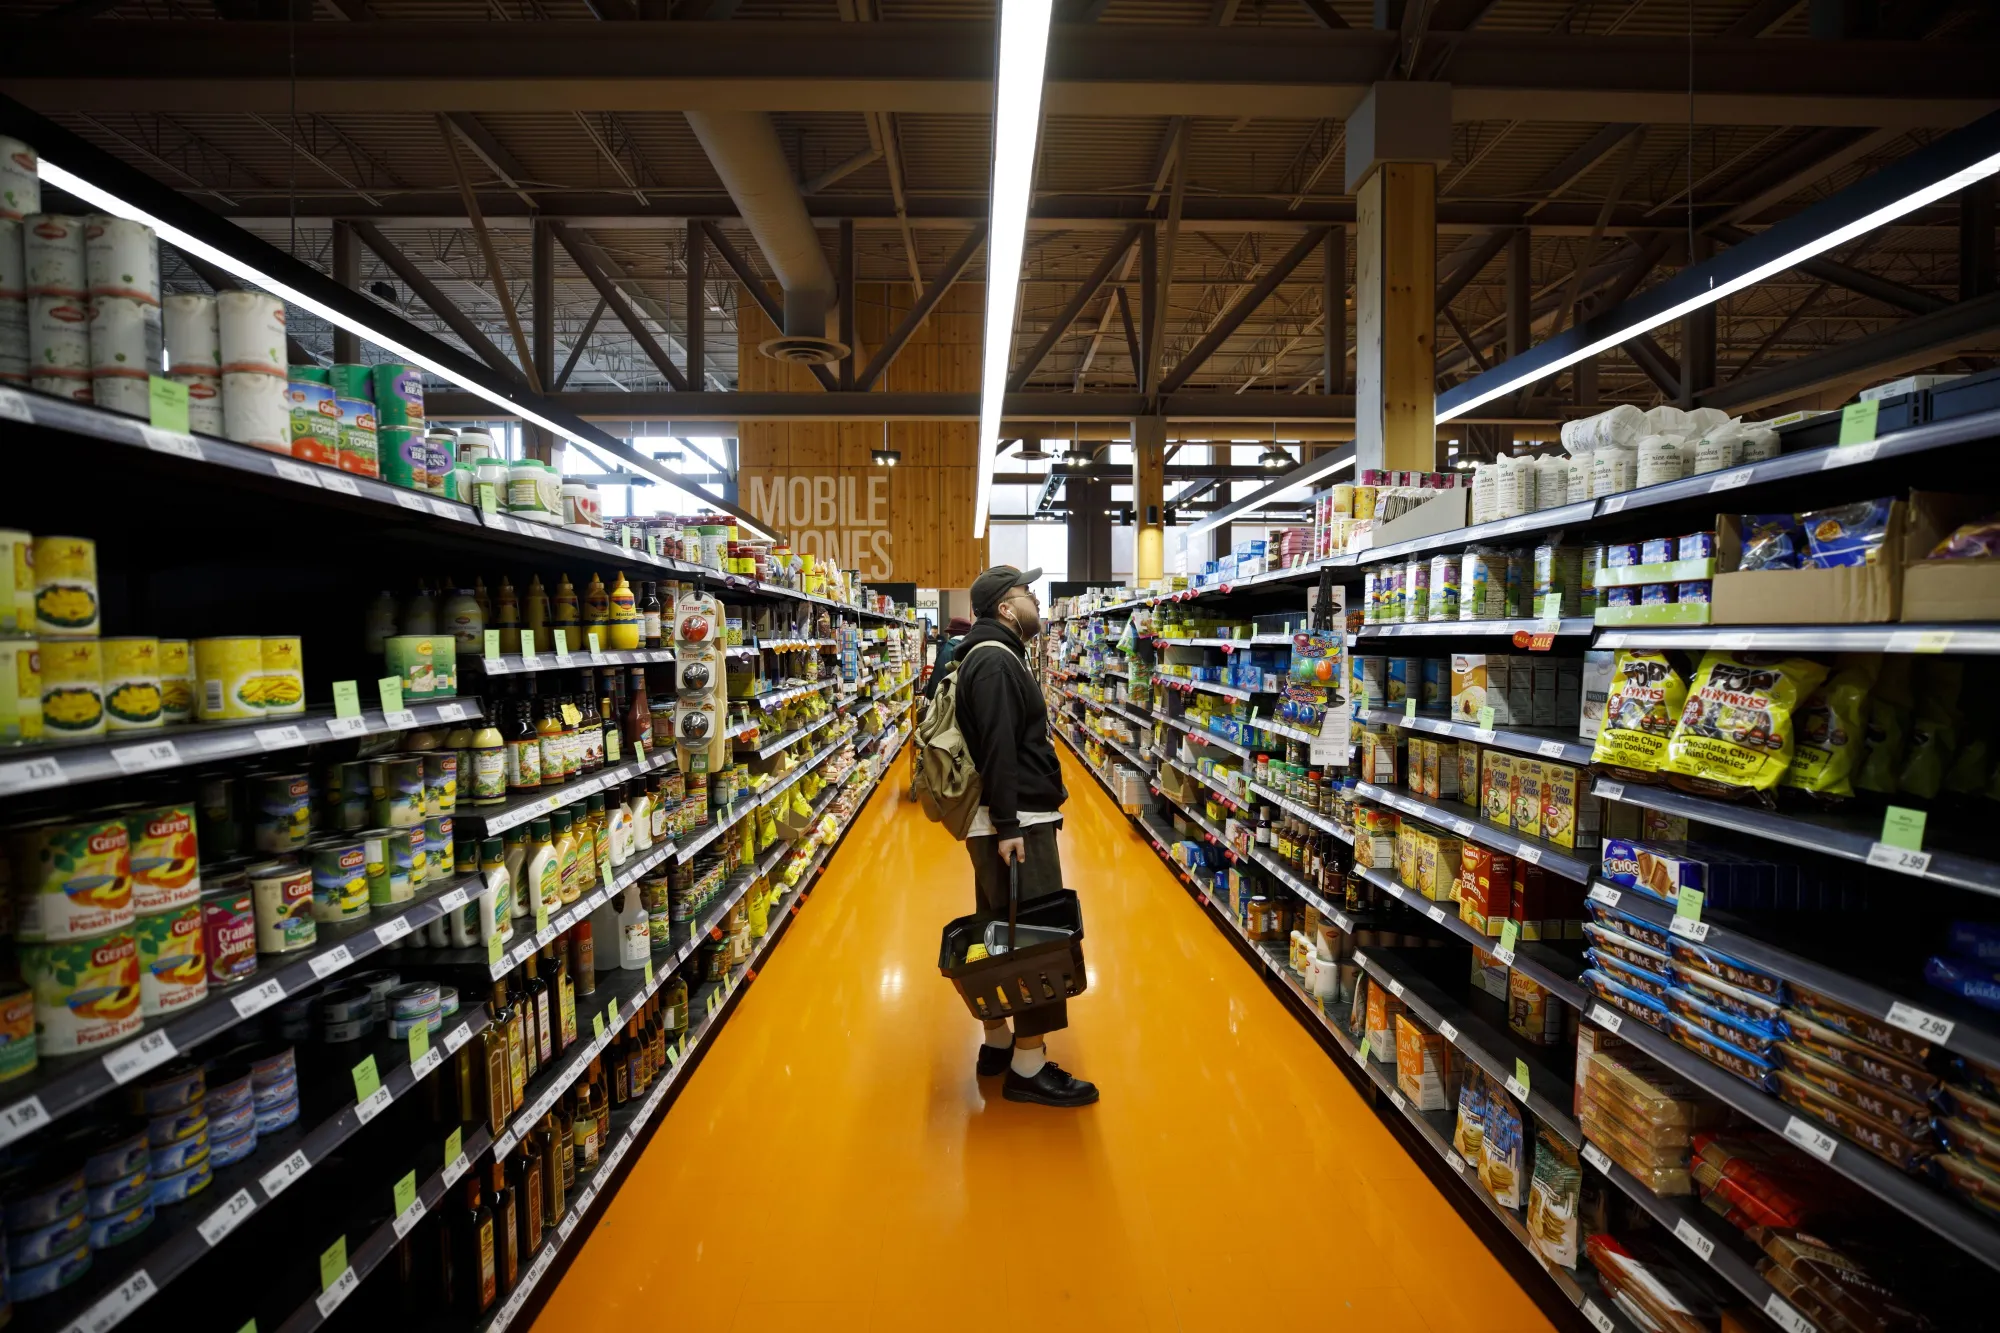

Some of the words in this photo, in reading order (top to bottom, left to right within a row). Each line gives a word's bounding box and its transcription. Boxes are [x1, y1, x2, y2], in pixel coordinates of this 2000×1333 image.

[405, 387, 422, 397] BEA
[311, 423, 338, 437] TOMA
[750, 476, 887, 527] MOBILE
[682, 604, 701, 612] Timer
[1514, 635, 1529, 645] SALE
[1532, 637, 1552, 648] SALE
[727, 664, 739, 674] its
[1587, 692, 1606, 702] WHOLE
[1609, 732, 1638, 744] Chocolate
[1640, 736, 1662, 749] Chip
[1610, 740, 1623, 750] Mini
[1625, 743, 1655, 756] Cookies
[1684, 739, 1727, 756] Chocolate
[1730, 747, 1756, 763] Chip
[1685, 749, 1705, 761] Mini
[1707, 753, 1745, 770] Cookies
[1491, 769, 1508, 780] Crisp
[1495, 777, 1511, 788] Snax
[1519, 776, 1537, 787] Crisp
[1523, 785, 1540, 796] Snax
[1551, 783, 1570, 796] Crisp
[1555, 793, 1573, 806] Snax
[149, 820, 190, 837] GEFEN
[1899, 853, 1926, 870] 2.99
[1462, 870, 1476, 884] Snack
[1606, 890, 1618, 901] 3.99
[69, 914, 113, 932] Peach
[1689, 923, 1705, 936] 3.49
[1510, 973, 1530, 990] Toast
[259, 983, 278, 1000] 3.49
[159, 993, 195, 1008] Peach
[1607, 1015, 1619, 1028] 7.99
[1919, 1017, 1947, 1037] 2.99
[77, 1024, 121, 1045] Peach
[140, 1035, 165, 1054] 6.99
[375, 1090, 388, 1105] 2.29
[1813, 1134, 1832, 1152] 7.99
[284, 1155, 306, 1176] 2.69
[456, 1156, 466, 1170] 9.49
[228, 1193, 249, 1215] 2.29
[410, 1200, 422, 1217] 9.49
[1696, 1236, 1711, 1254] 1.19
[340, 1271, 354, 1290] 9.49
[121, 1276, 148, 1302] 2.49
[1793, 1317, 1812, 1333] 1.19
